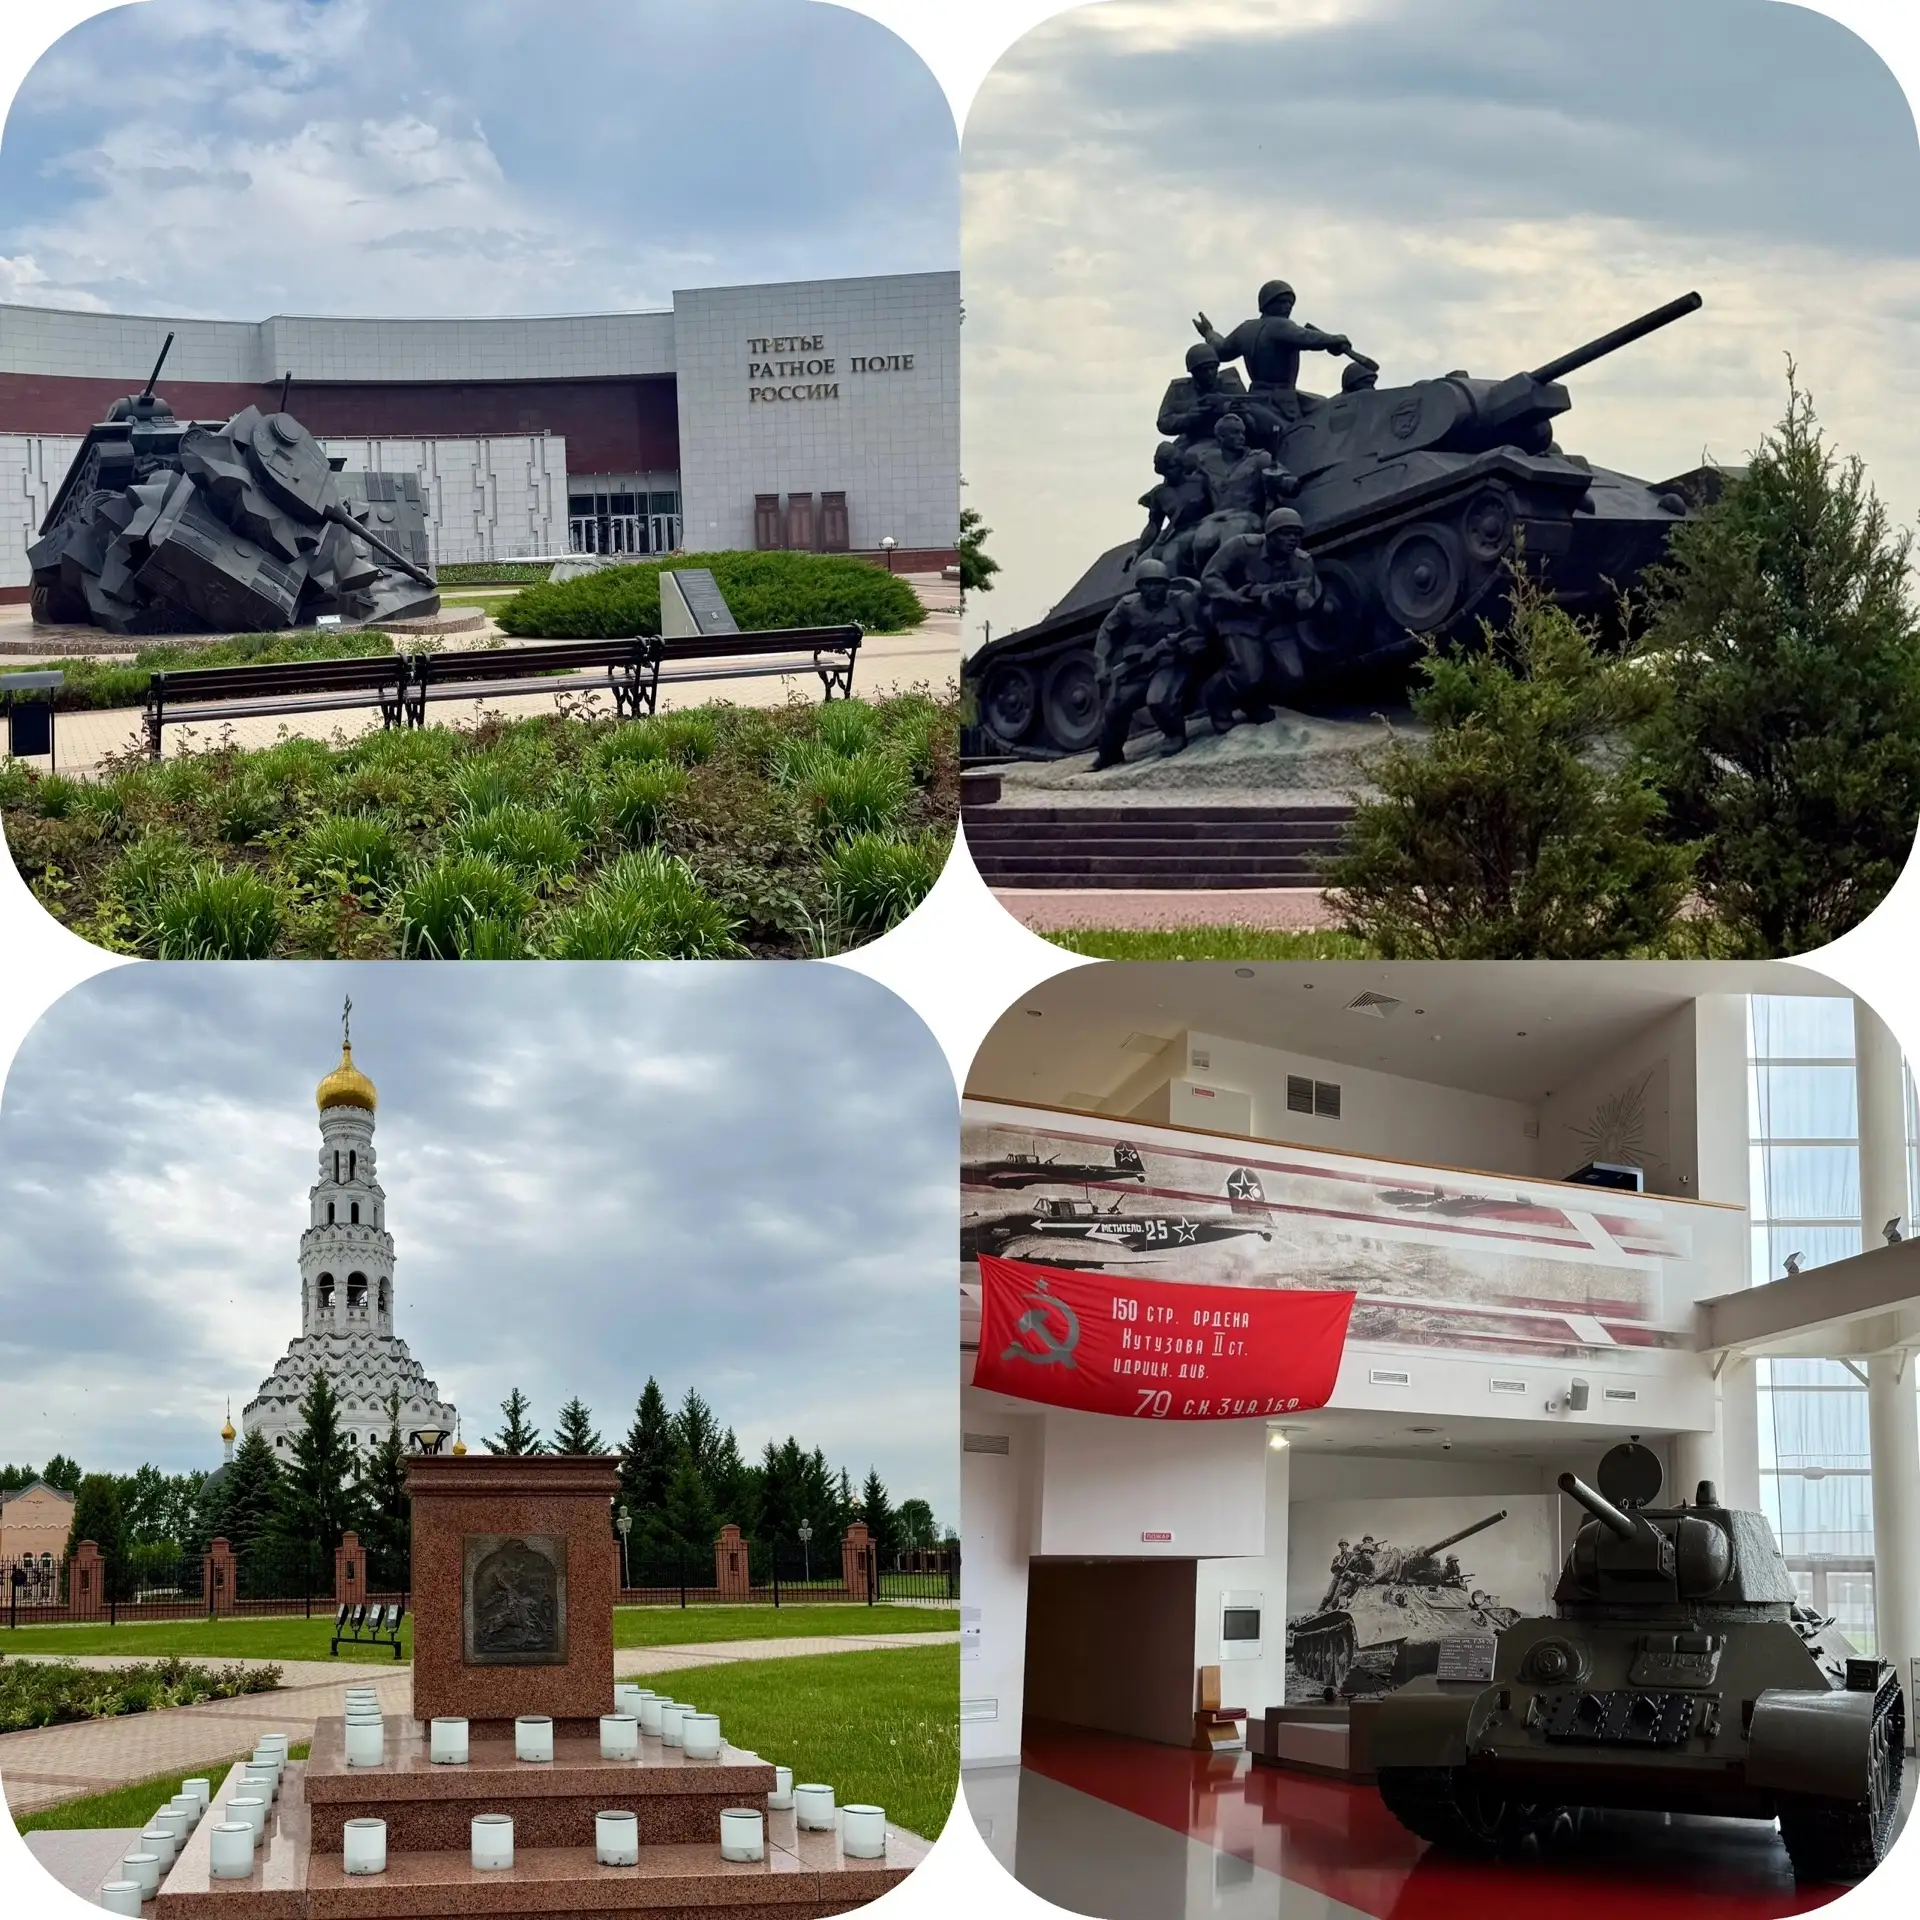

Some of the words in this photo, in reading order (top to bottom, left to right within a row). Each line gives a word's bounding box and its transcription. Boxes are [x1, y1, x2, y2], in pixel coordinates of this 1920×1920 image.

[747, 335, 824, 354] ТРЕТЬЕ
[749, 358, 836, 378] РАТНОЕ
[850, 354, 914, 373] ПОЛЕ
[749, 384, 839, 402] РОССИИ
[1144, 1219, 1168, 1240] 25
[1112, 1297, 1138, 1321] 150
[1146, 1306, 1179, 1325] СТР.
[1193, 1310, 1249, 1328] ОРДЕНА
[1113, 1357, 1172, 1378] ИДРИЦК.
[1178, 1363, 1209, 1379] ДИВ.
[1132, 1388, 1173, 1418] 79
[1183, 1399, 1211, 1415] С.К.
